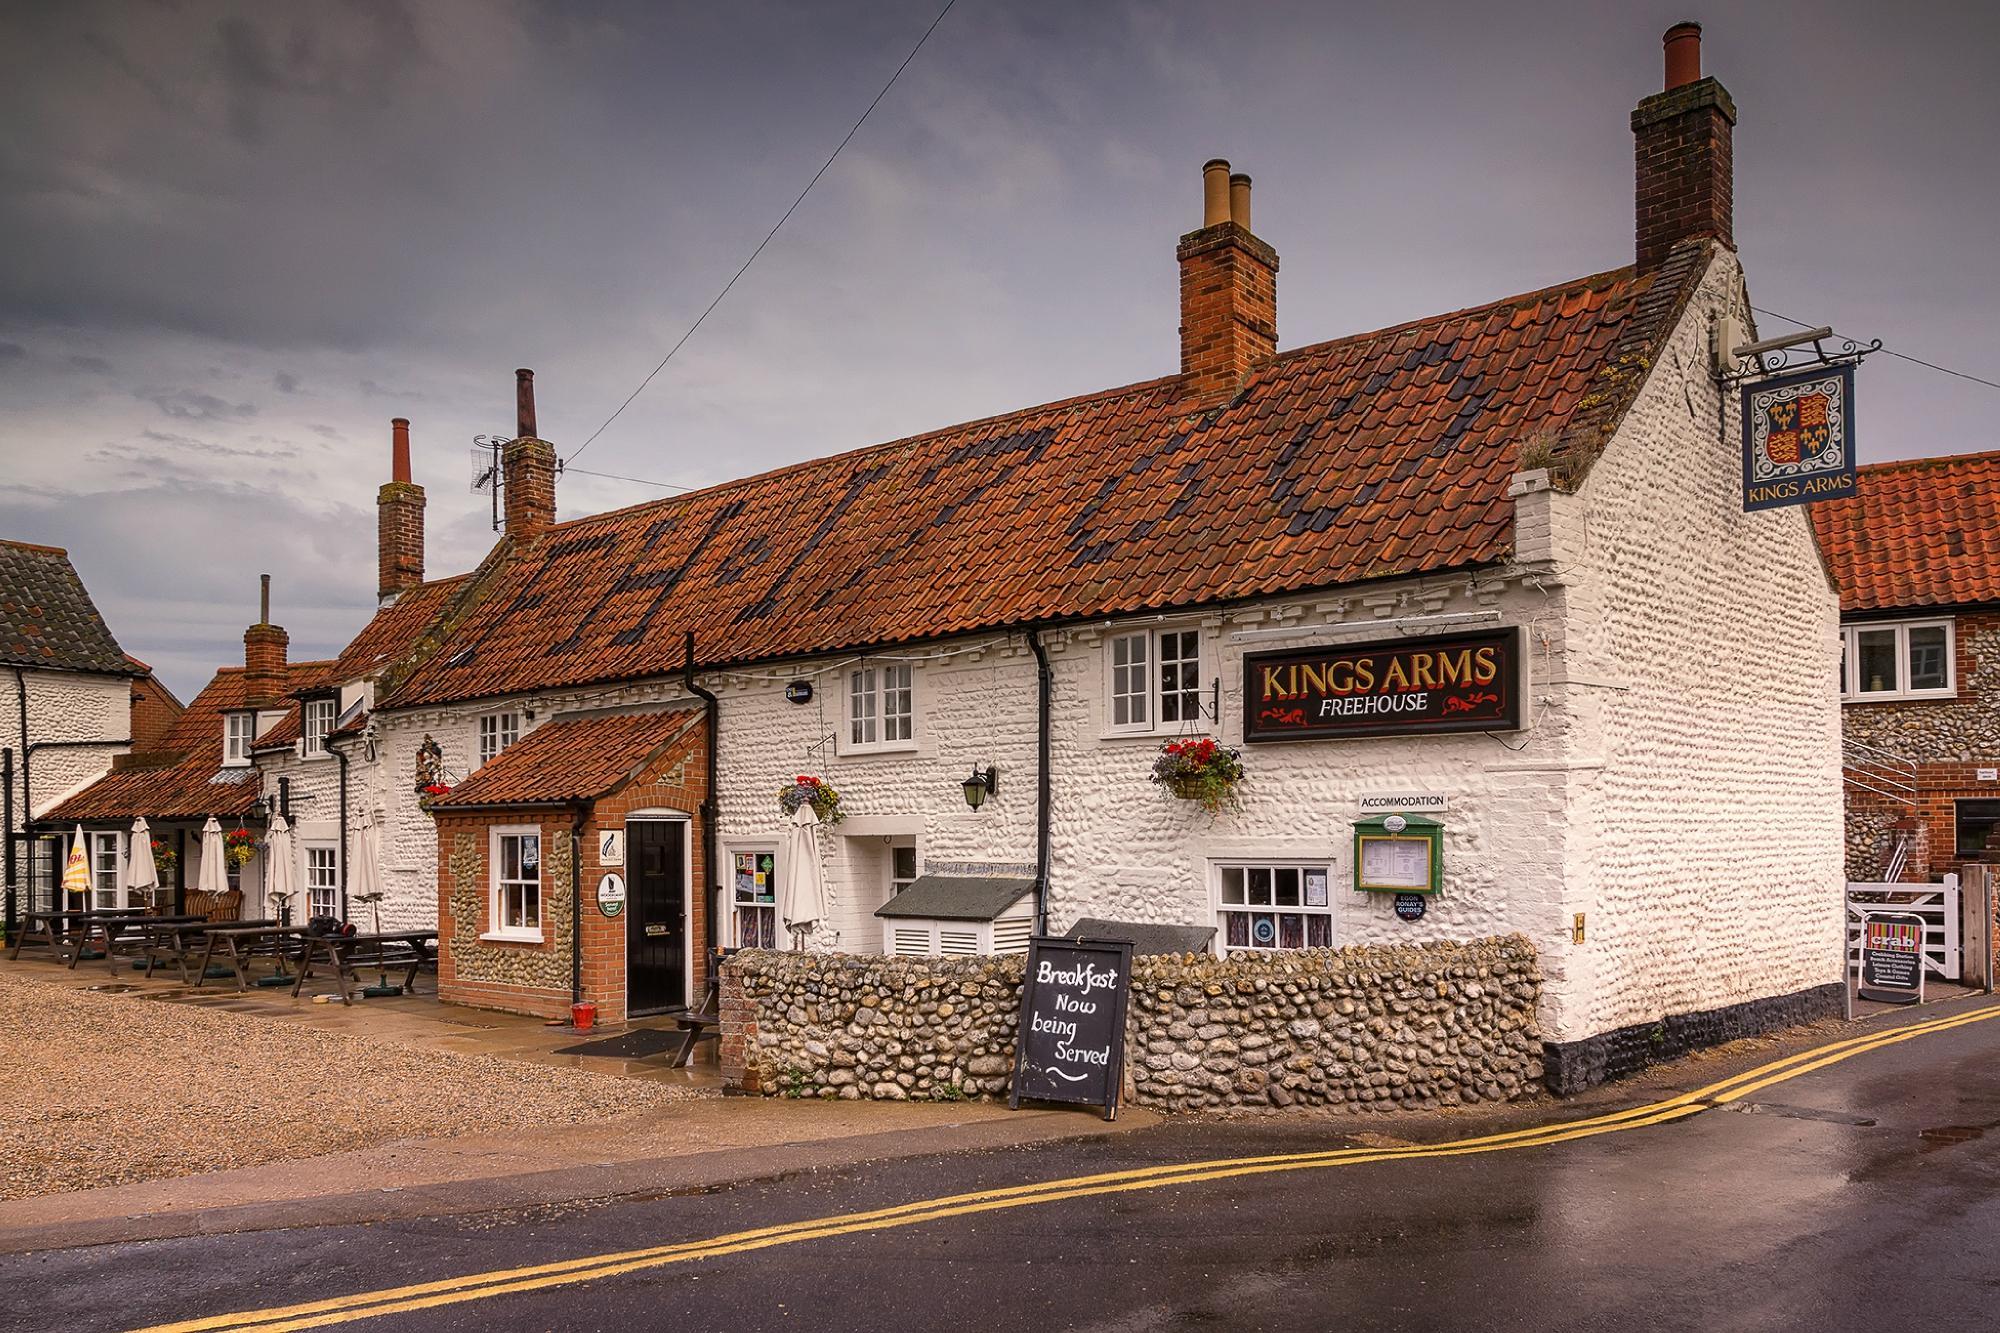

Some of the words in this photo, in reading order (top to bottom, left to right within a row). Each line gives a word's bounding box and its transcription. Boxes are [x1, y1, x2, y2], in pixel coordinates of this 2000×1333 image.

[1748, 481, 1800, 503] KINGS
[1802, 473, 1853, 495] ARMS
[1263, 659, 1375, 700] KINGS
[1379, 647, 1497, 693] ARMS
[1318, 692, 1429, 717] FREEHOUSE
[1361, 796, 1444, 808] ACCOMMODATION
[1871, 936, 1915, 947] crab
[1036, 960, 1118, 995] Breakfast
[1055, 993, 1096, 1014] Now
[1031, 1010, 1077, 1045] being
[1054, 1040, 1110, 1066] Served
